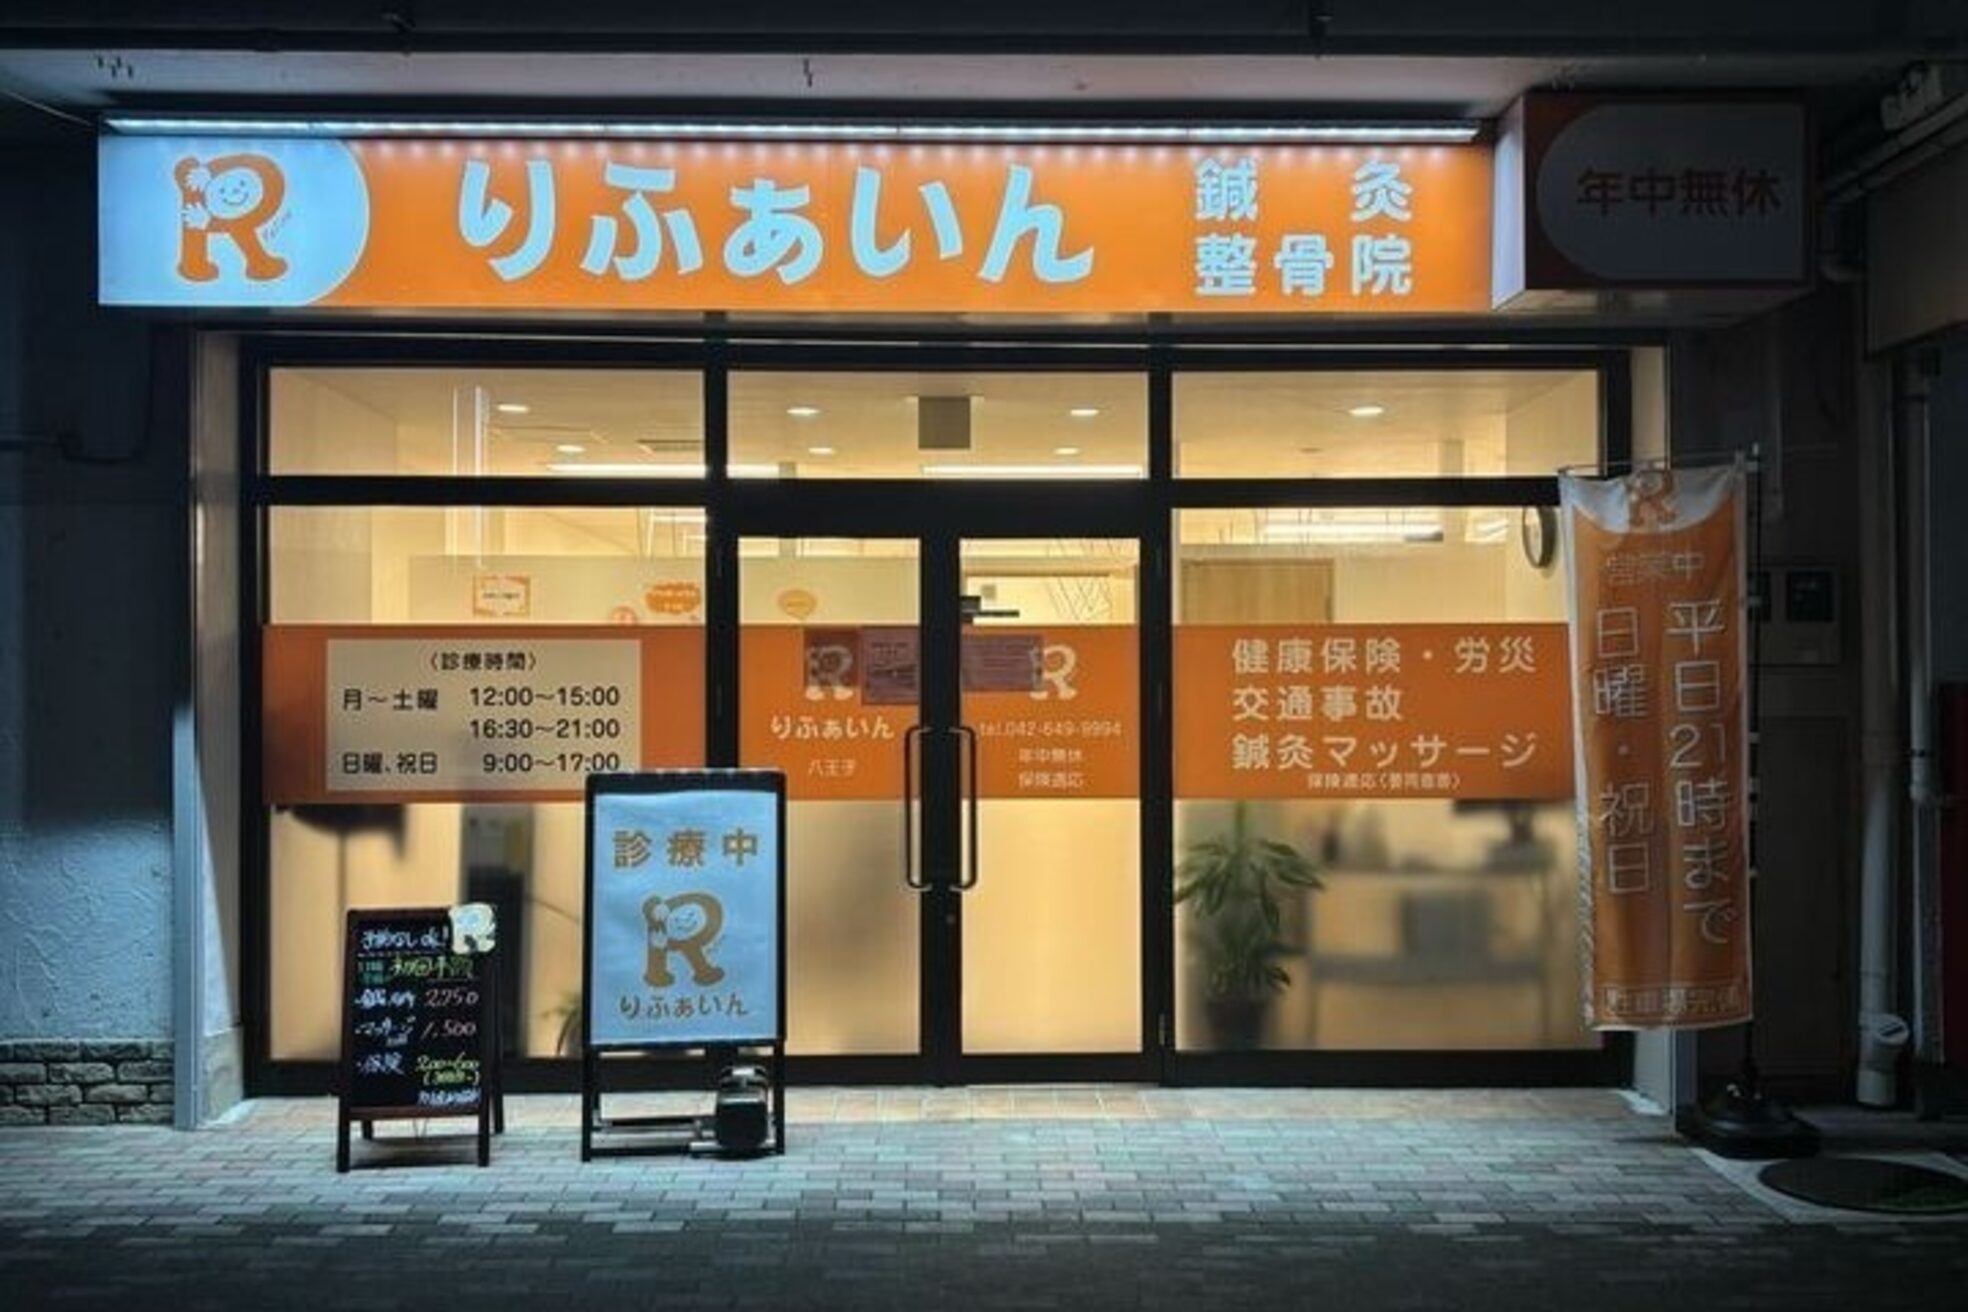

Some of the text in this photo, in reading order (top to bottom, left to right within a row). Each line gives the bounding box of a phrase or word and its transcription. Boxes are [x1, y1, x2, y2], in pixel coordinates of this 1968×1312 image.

[1577, 167, 1782, 217] 年中無休
[457, 159, 1094, 282] りふぁいん
[1195, 233, 1412, 297] 整骨院
[1232, 636, 1536, 674] 健康保険・労災
[469, 686, 620, 706] 12:00～15:00
[1232, 686, 1403, 722] 交通事故
[469, 719, 620, 739] 16:30～21:00
[771, 715, 894, 740] りふぁいん
[808, 757, 856, 777] 八王子
[1232, 733, 1538, 770] 鍼灸マッサージ
[1593, 606, 1649, 894] 日曜・祝日
[612, 827, 759, 868] 診療中
[619, 995, 749, 1019] りふぁいん
